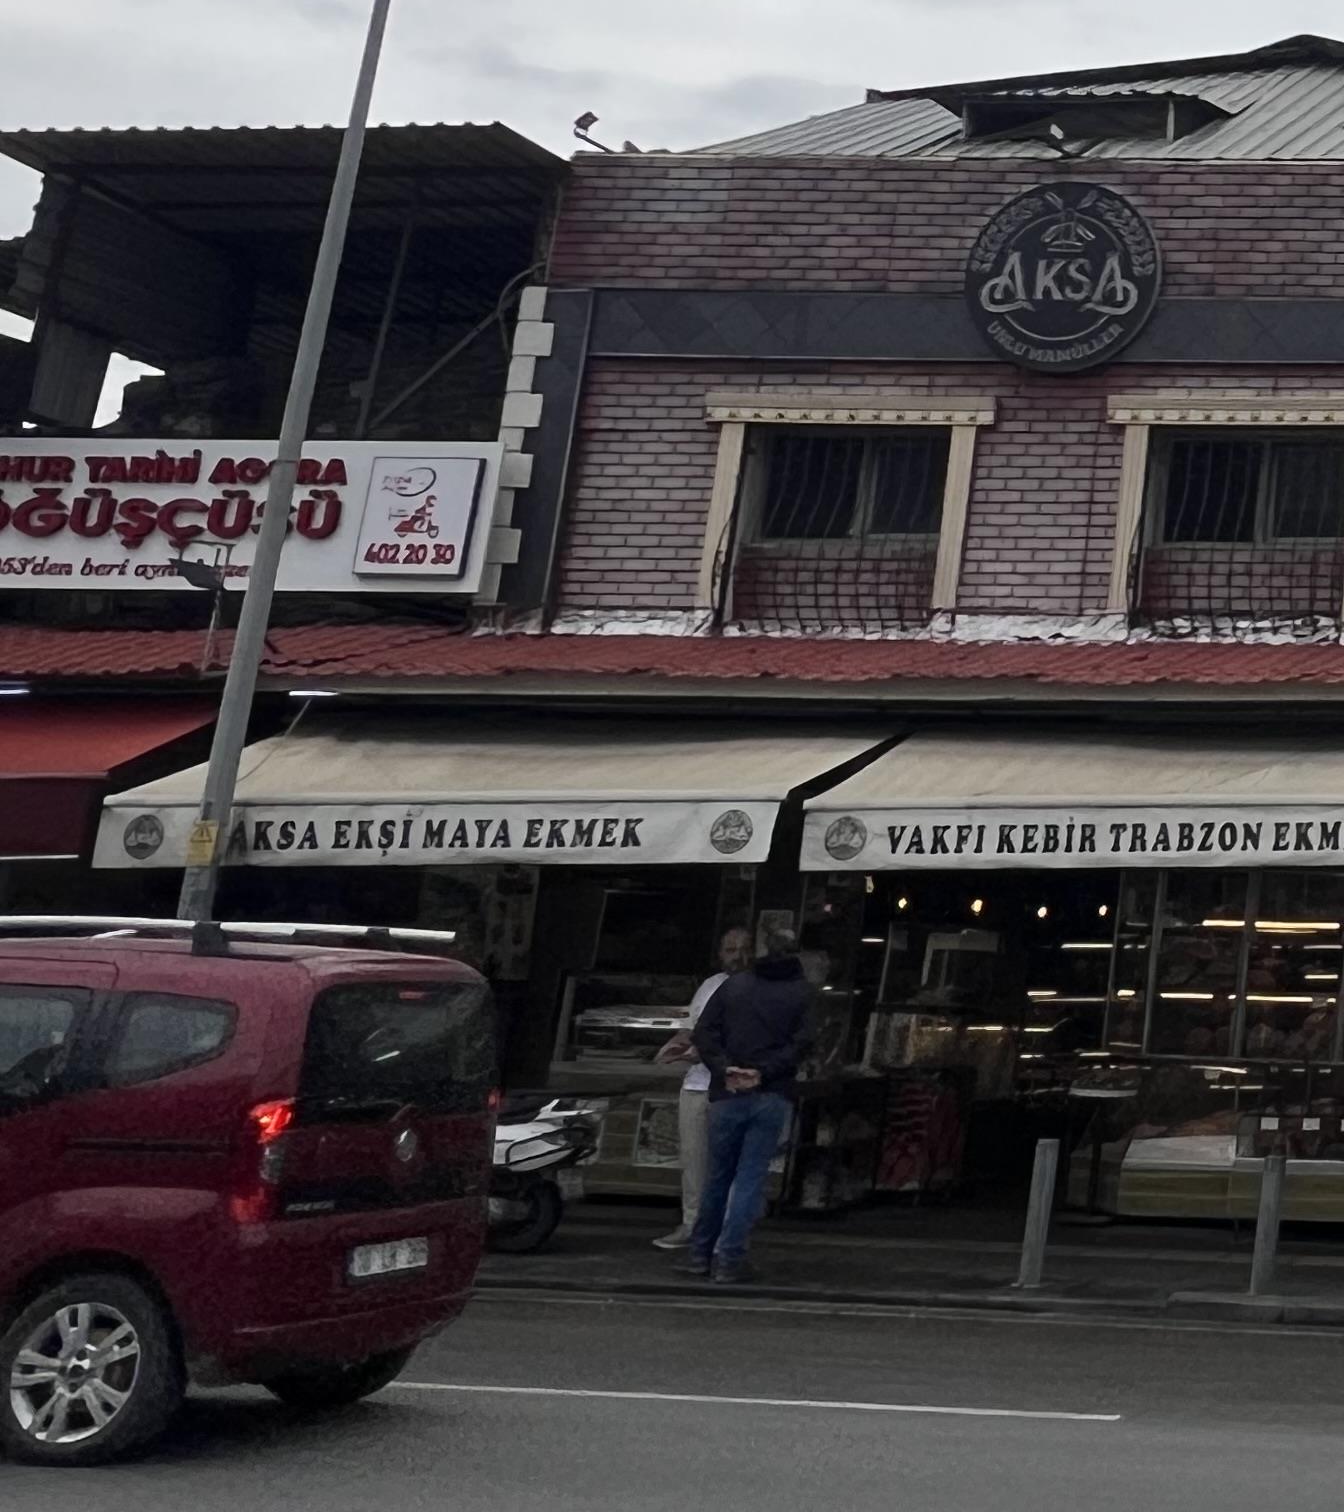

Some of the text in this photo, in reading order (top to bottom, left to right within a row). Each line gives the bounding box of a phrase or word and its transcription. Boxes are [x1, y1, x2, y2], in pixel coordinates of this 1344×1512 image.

[980, 250, 1139, 316] AKSA
[208, 457, 347, 486] AGRA
[402, 543, 428, 565] 20
[226, 811, 644, 857] AKSA EKŞİ MAYA EKMEK
[887, 824, 986, 855] VAKFI
[996, 816, 1097, 854] KEBİR
[1110, 821, 1263, 853] TRABZON
